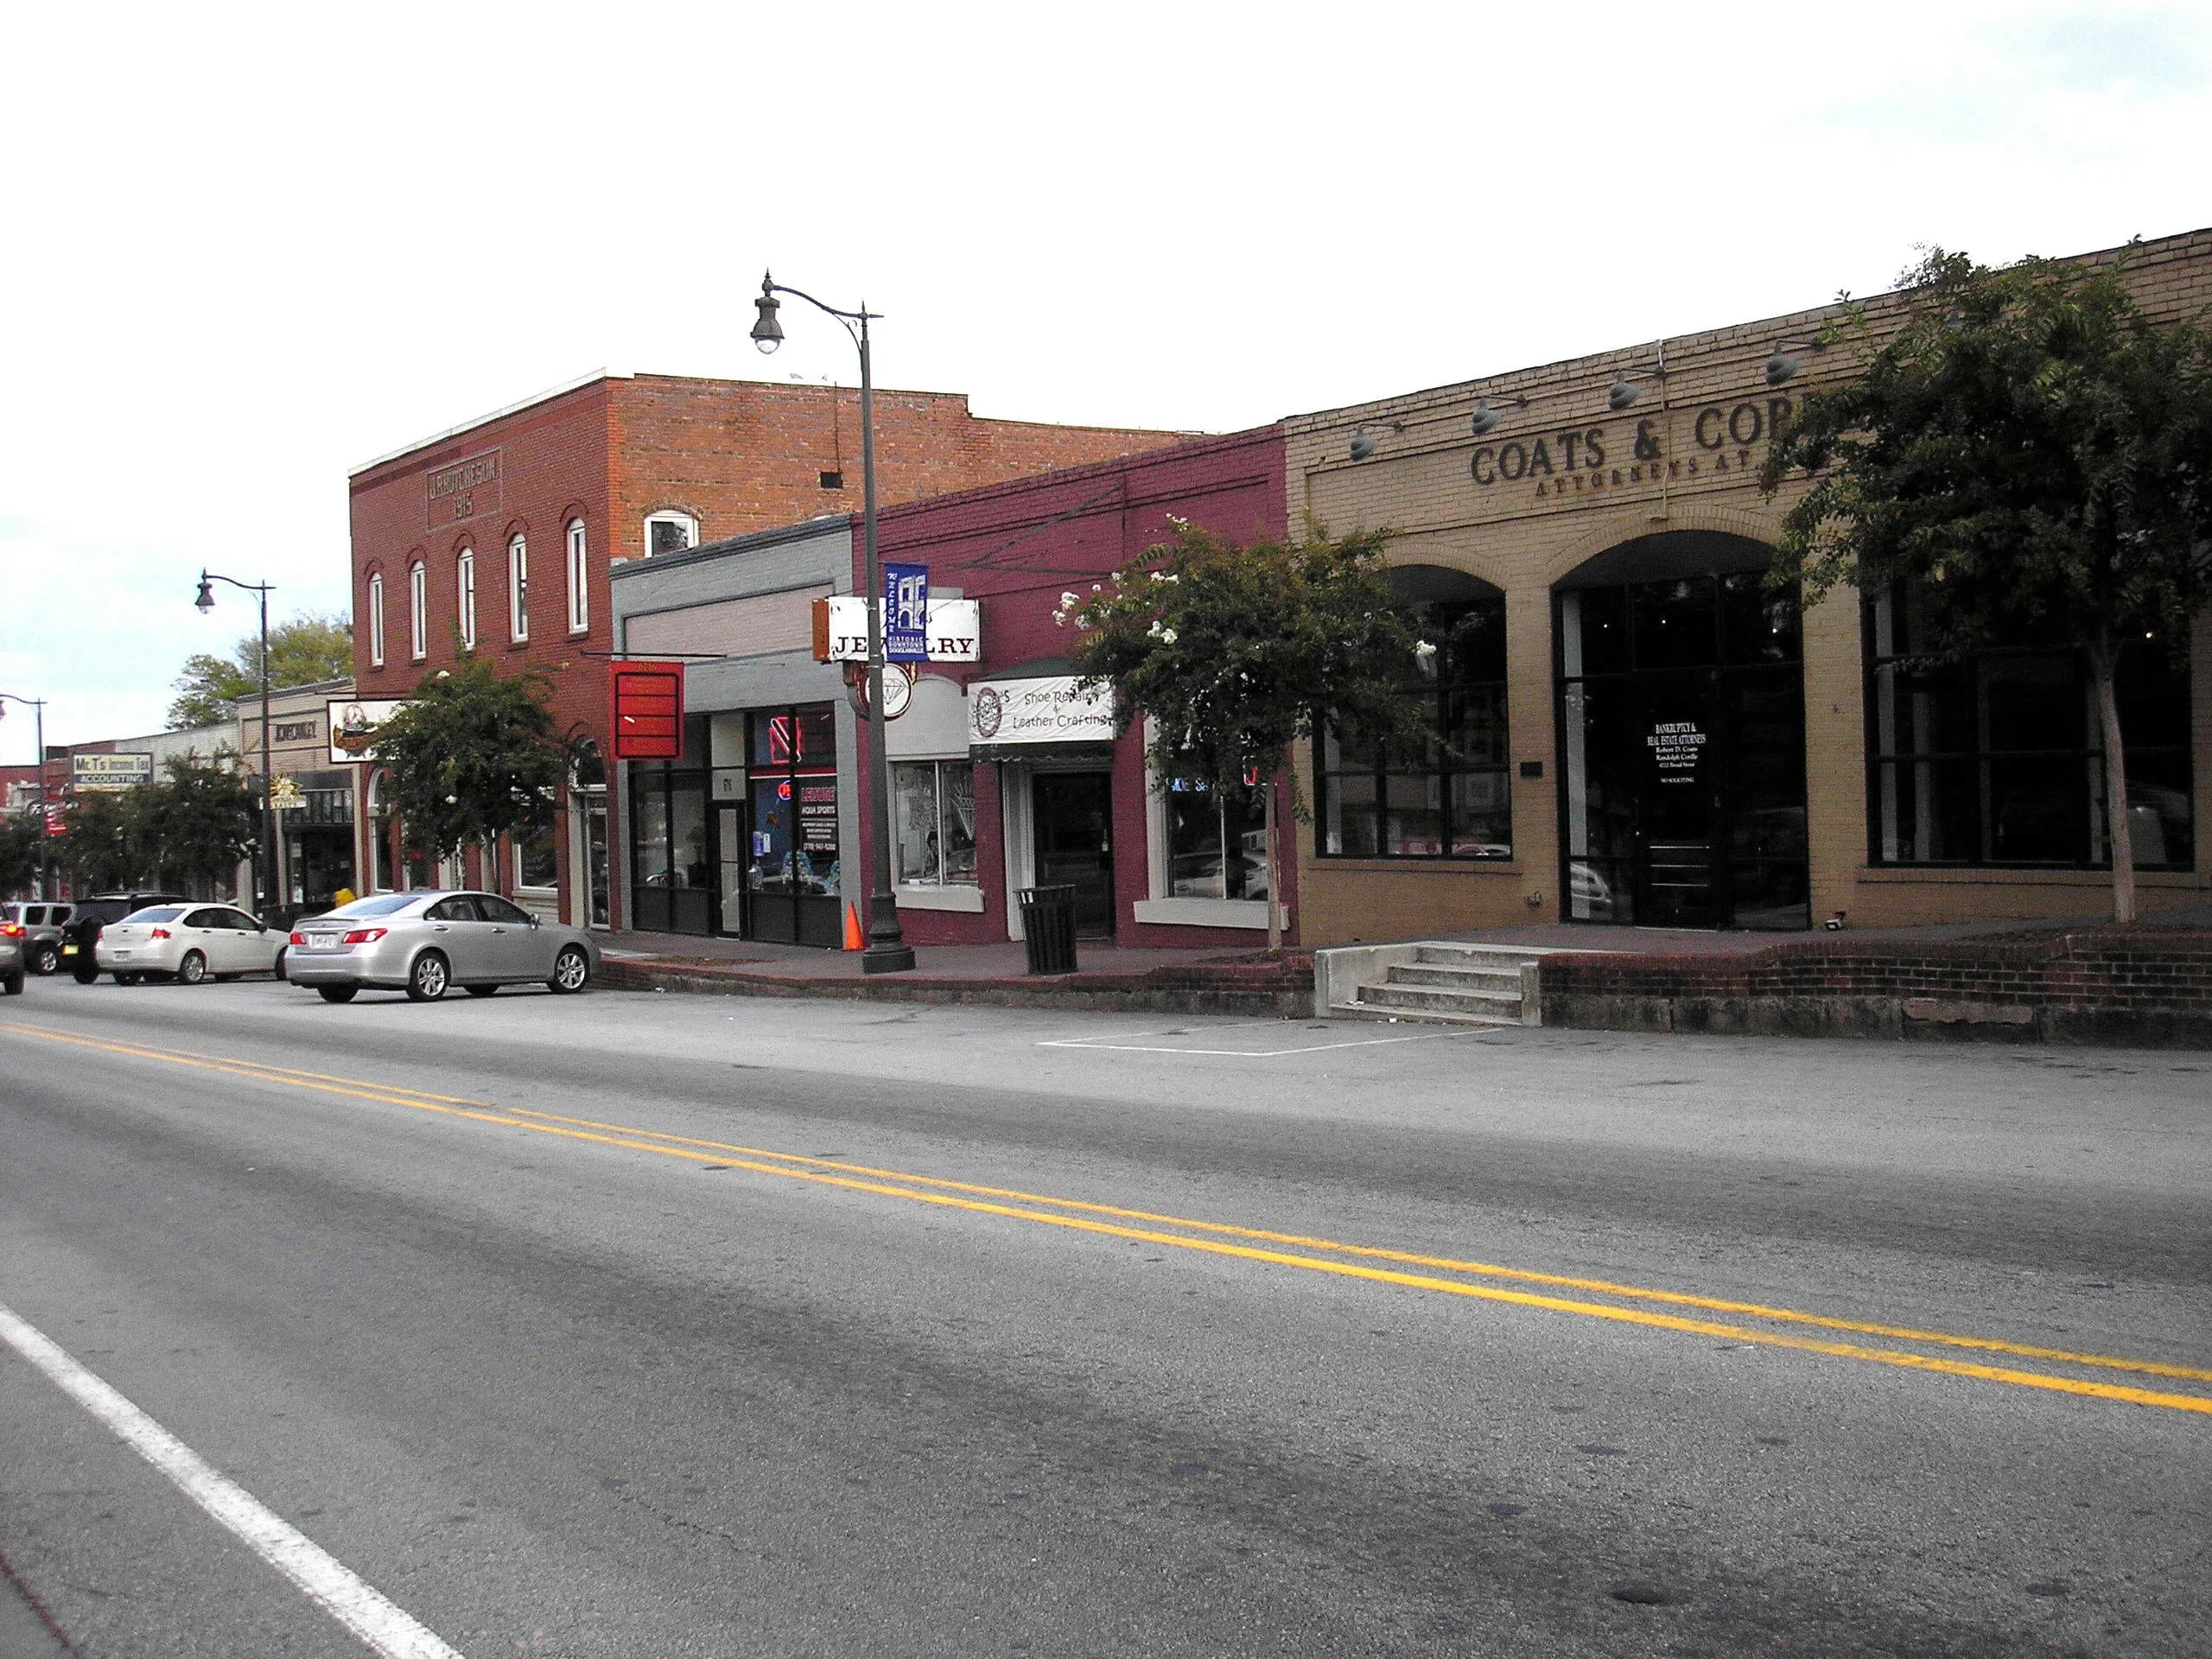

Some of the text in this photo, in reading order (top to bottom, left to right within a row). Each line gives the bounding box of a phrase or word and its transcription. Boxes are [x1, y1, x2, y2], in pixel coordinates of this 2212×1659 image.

[1471, 428, 1605, 485] COATS
[1633, 419, 1662, 461] &
[1535, 458, 1699, 497] ATTORNEYS
[887, 573, 899, 633] WELCOME
[835, 635, 976, 654] JELRY
[1024, 690, 1052, 705] Shoe
[1013, 714, 1109, 729] Leather Crafting
[1655, 722, 1697, 734] BANKRUPTCY &
[1647, 736, 1660, 746] REAL
[1661, 735, 1678, 746] ESTATE
[80, 774, 144, 784] ACCOUNTING
[817, 805, 836, 815] SPORTS
